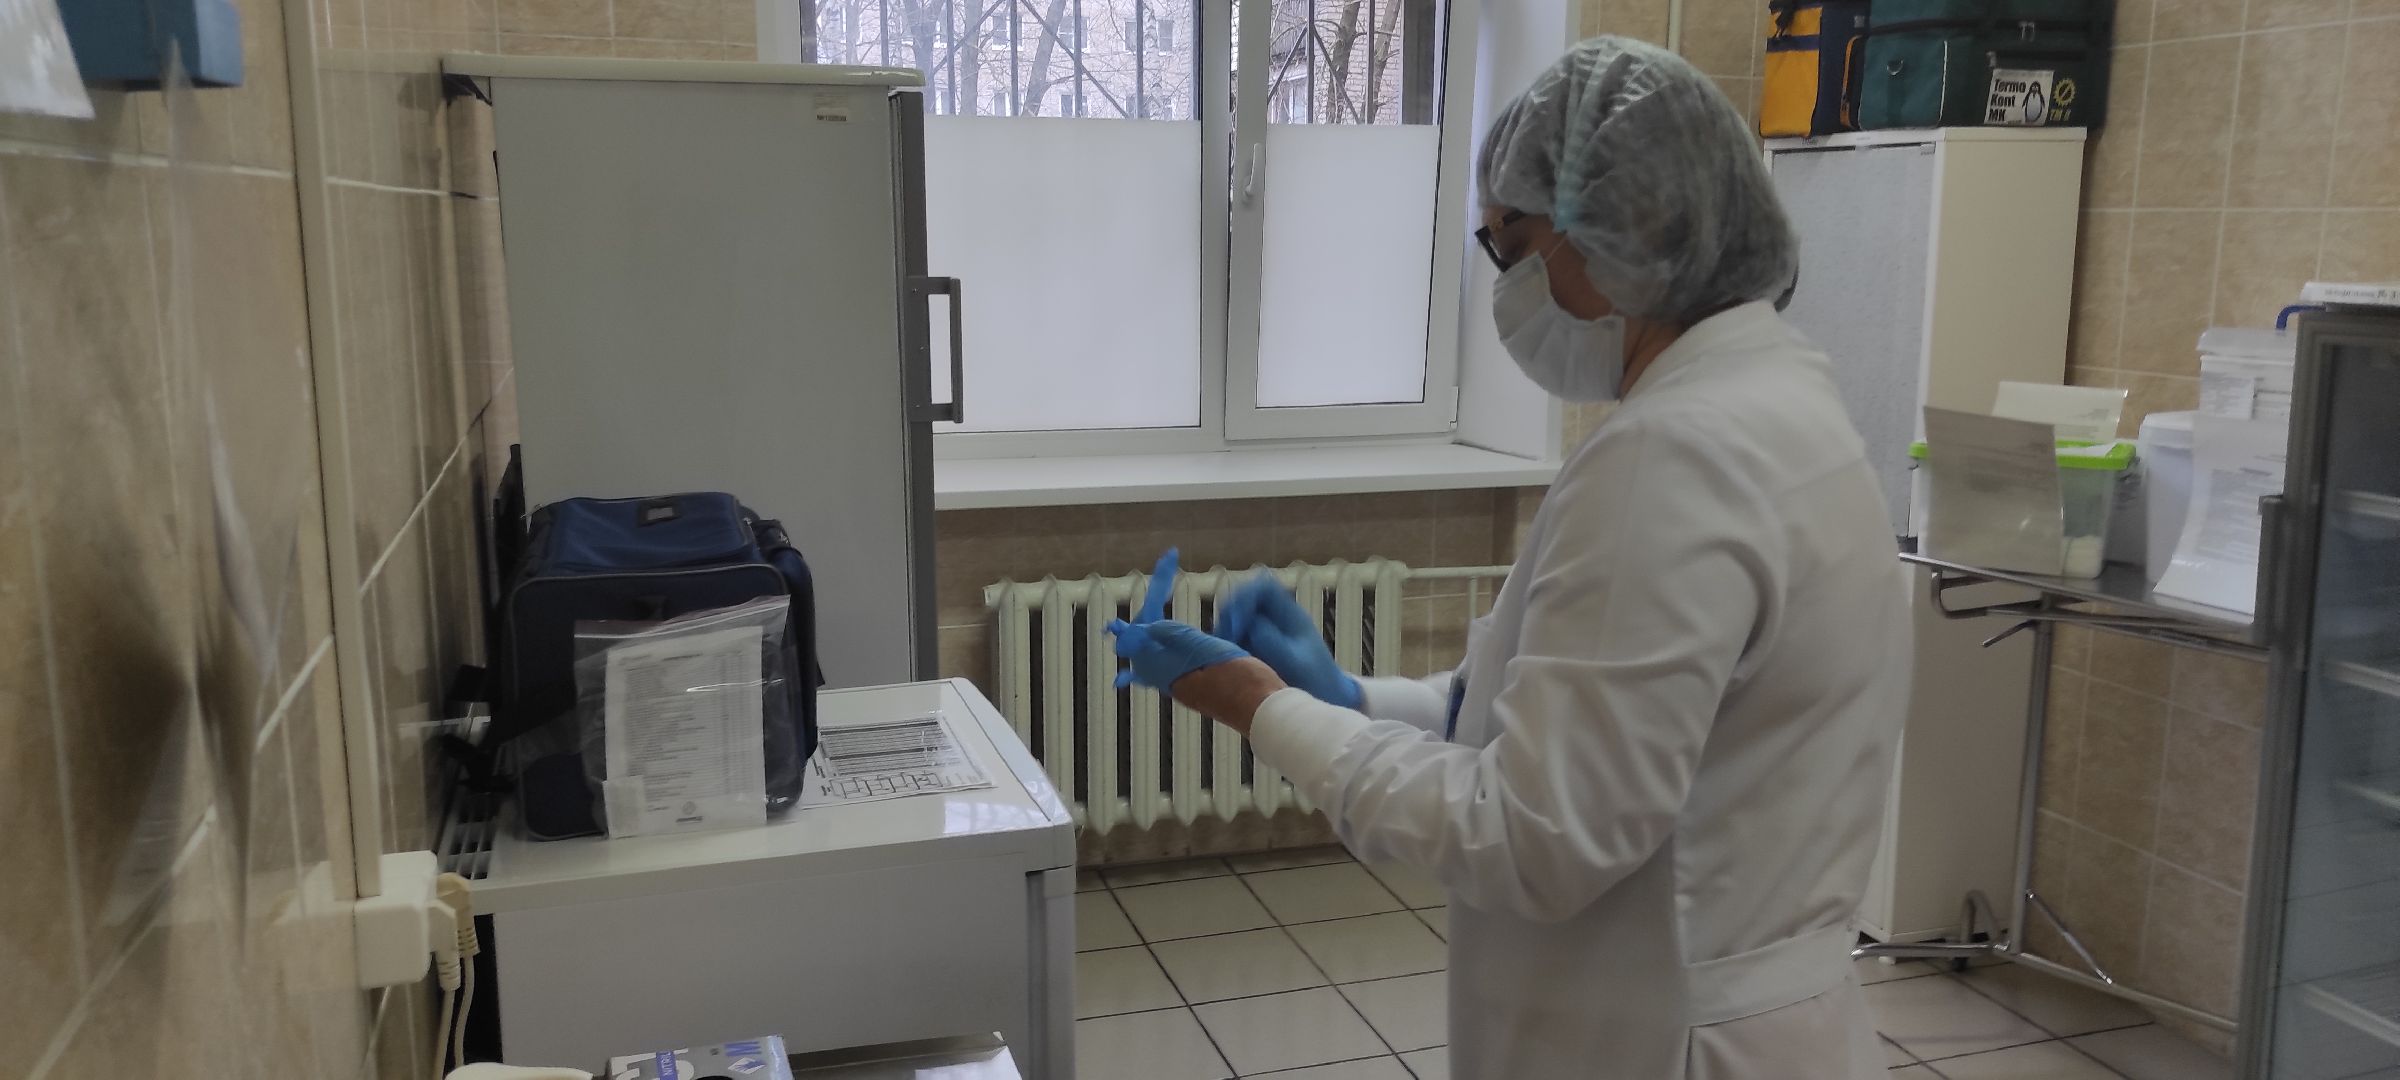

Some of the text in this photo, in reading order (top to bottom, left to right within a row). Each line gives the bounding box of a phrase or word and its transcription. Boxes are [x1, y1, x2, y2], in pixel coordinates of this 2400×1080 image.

[1994, 79, 2027, 93] Termo
[1990, 93, 2016, 107] Kont
[723, 1041, 762, 1057] M
